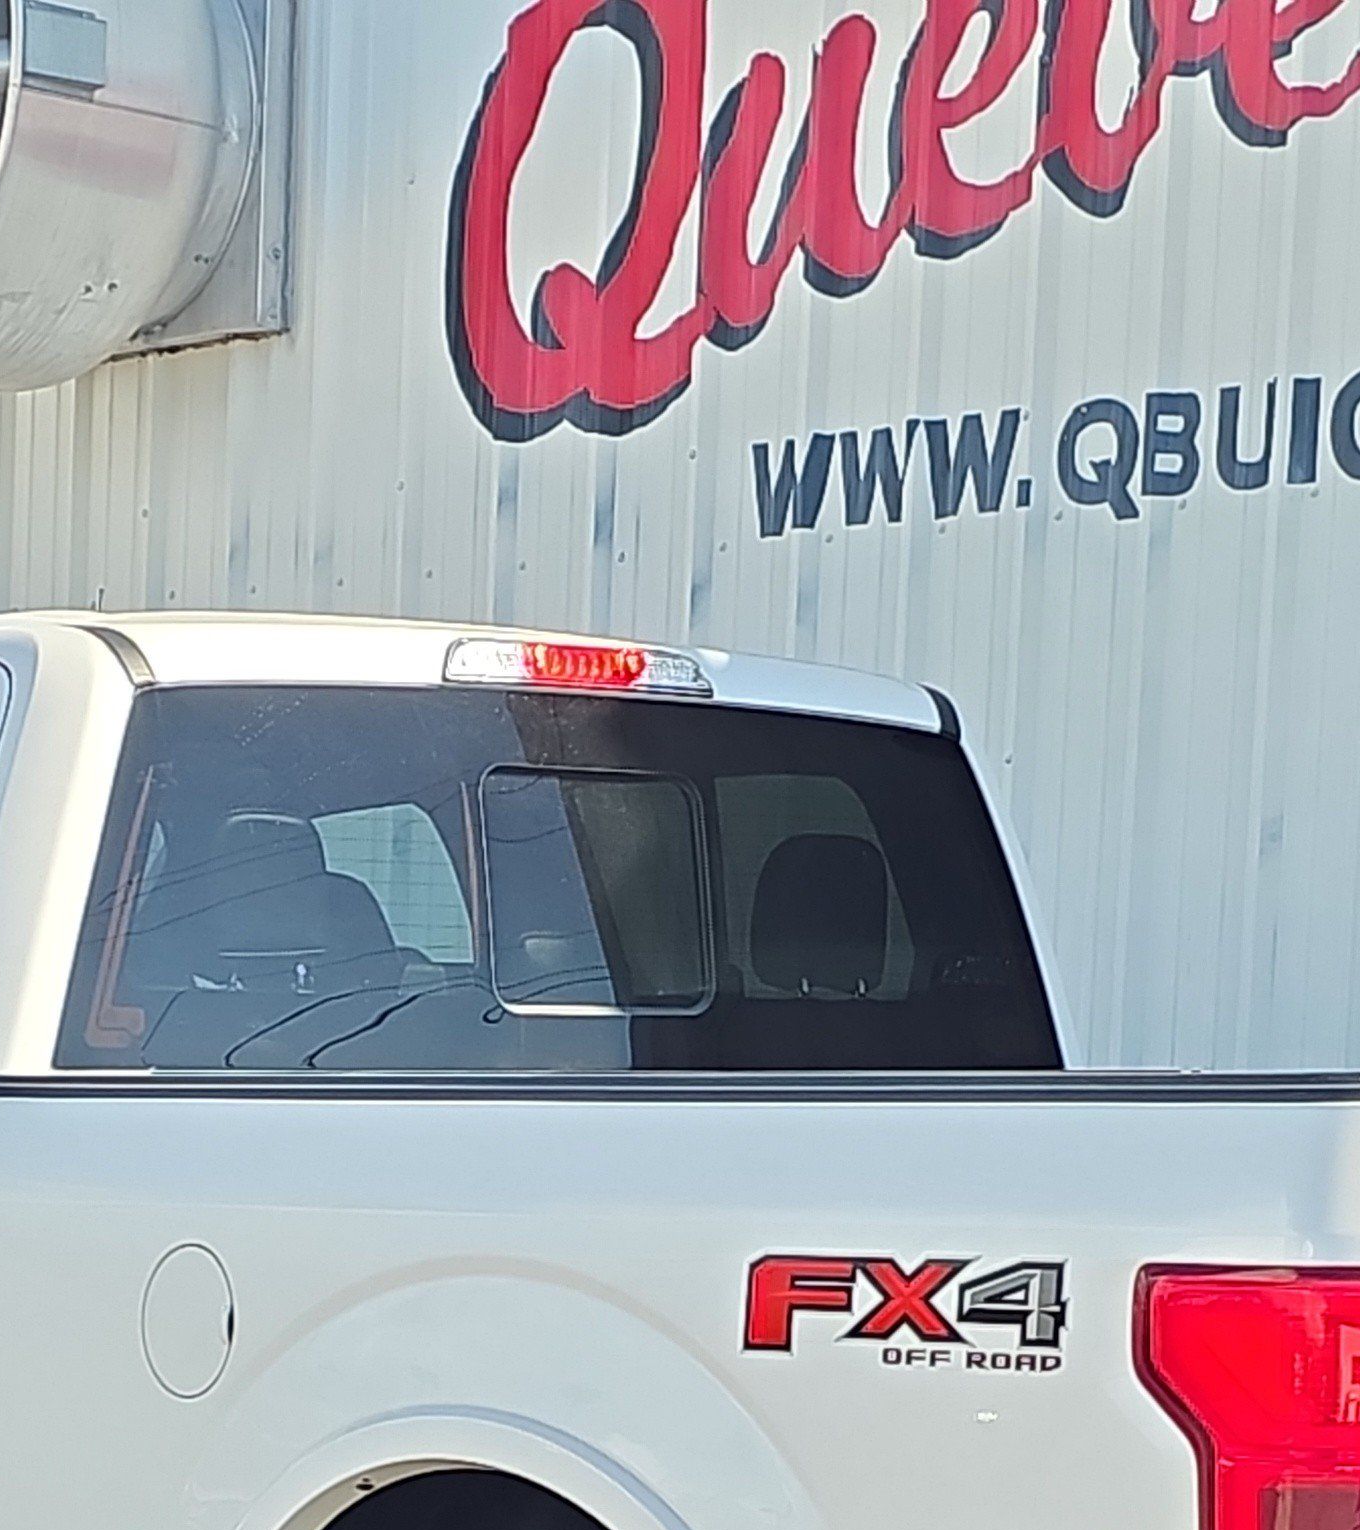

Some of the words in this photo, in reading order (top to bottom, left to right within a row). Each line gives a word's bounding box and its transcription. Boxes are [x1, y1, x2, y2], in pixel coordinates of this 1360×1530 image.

[742, 1254, 1068, 1352] FX4
[882, 1348, 951, 1368] OFF
[965, 1350, 1062, 1372] ROAD
